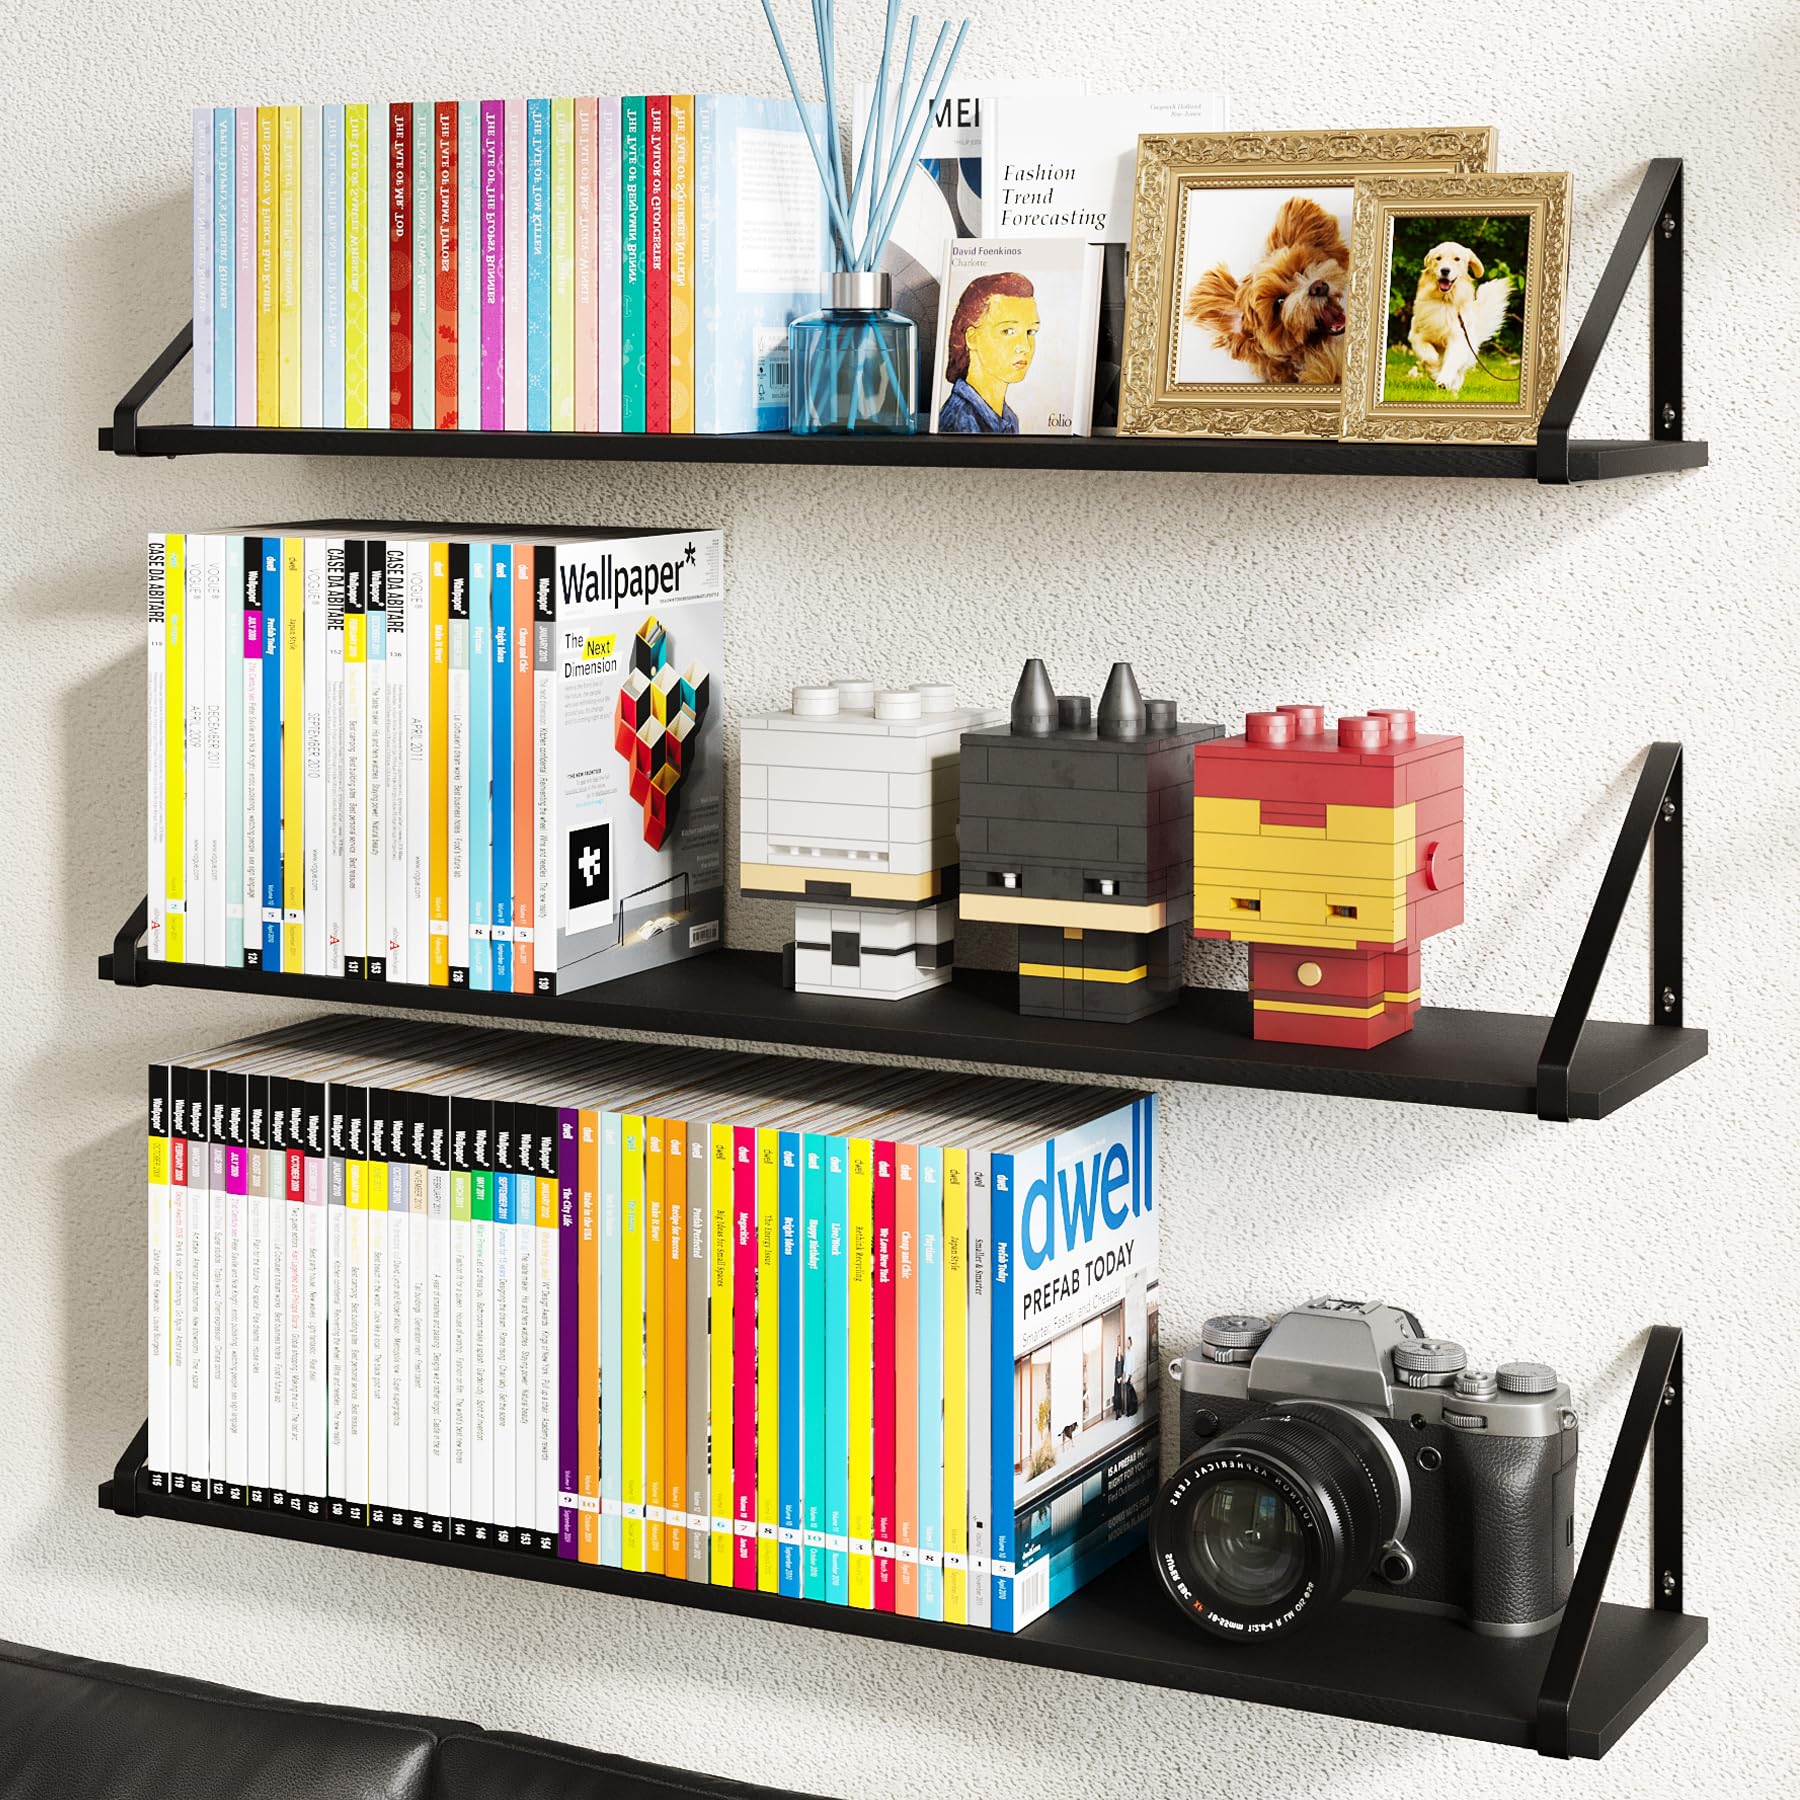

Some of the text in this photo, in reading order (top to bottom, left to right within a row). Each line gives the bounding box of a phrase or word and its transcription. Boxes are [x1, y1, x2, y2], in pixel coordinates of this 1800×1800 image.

[1003, 163, 1076, 182] Fashion
[1001, 187, 1054, 205] Trend
[1001, 207, 1107, 231] Forecasting
[951, 258, 988, 268] Charlotte
[952, 246, 1022, 256] David Foenkinos
[1047, 413, 1072, 428] folio
[148, 542, 165, 623] CASE DA ABITARE
[327, 548, 345, 631] CASE DA ABITARE
[386, 550, 404, 633] CASE DA ABITARE
[564, 633, 584, 649] The
[586, 640, 611, 657] Next
[564, 658, 617, 678] Dimension
[207, 704, 220, 769] DECEMBER 2011
[995, 1174, 1009, 1192] dwell
[1021, 1094, 1153, 1271] dwell
[714, 1209, 726, 1287] Big Ideas for Small Spaces
[974, 1238, 984, 1262] Smaller
[995, 1241, 1008, 1284] Prefab Today
[974, 1269, 984, 1296] Smarter
[1023, 1239, 1135, 1321] PREFAB TODAY
